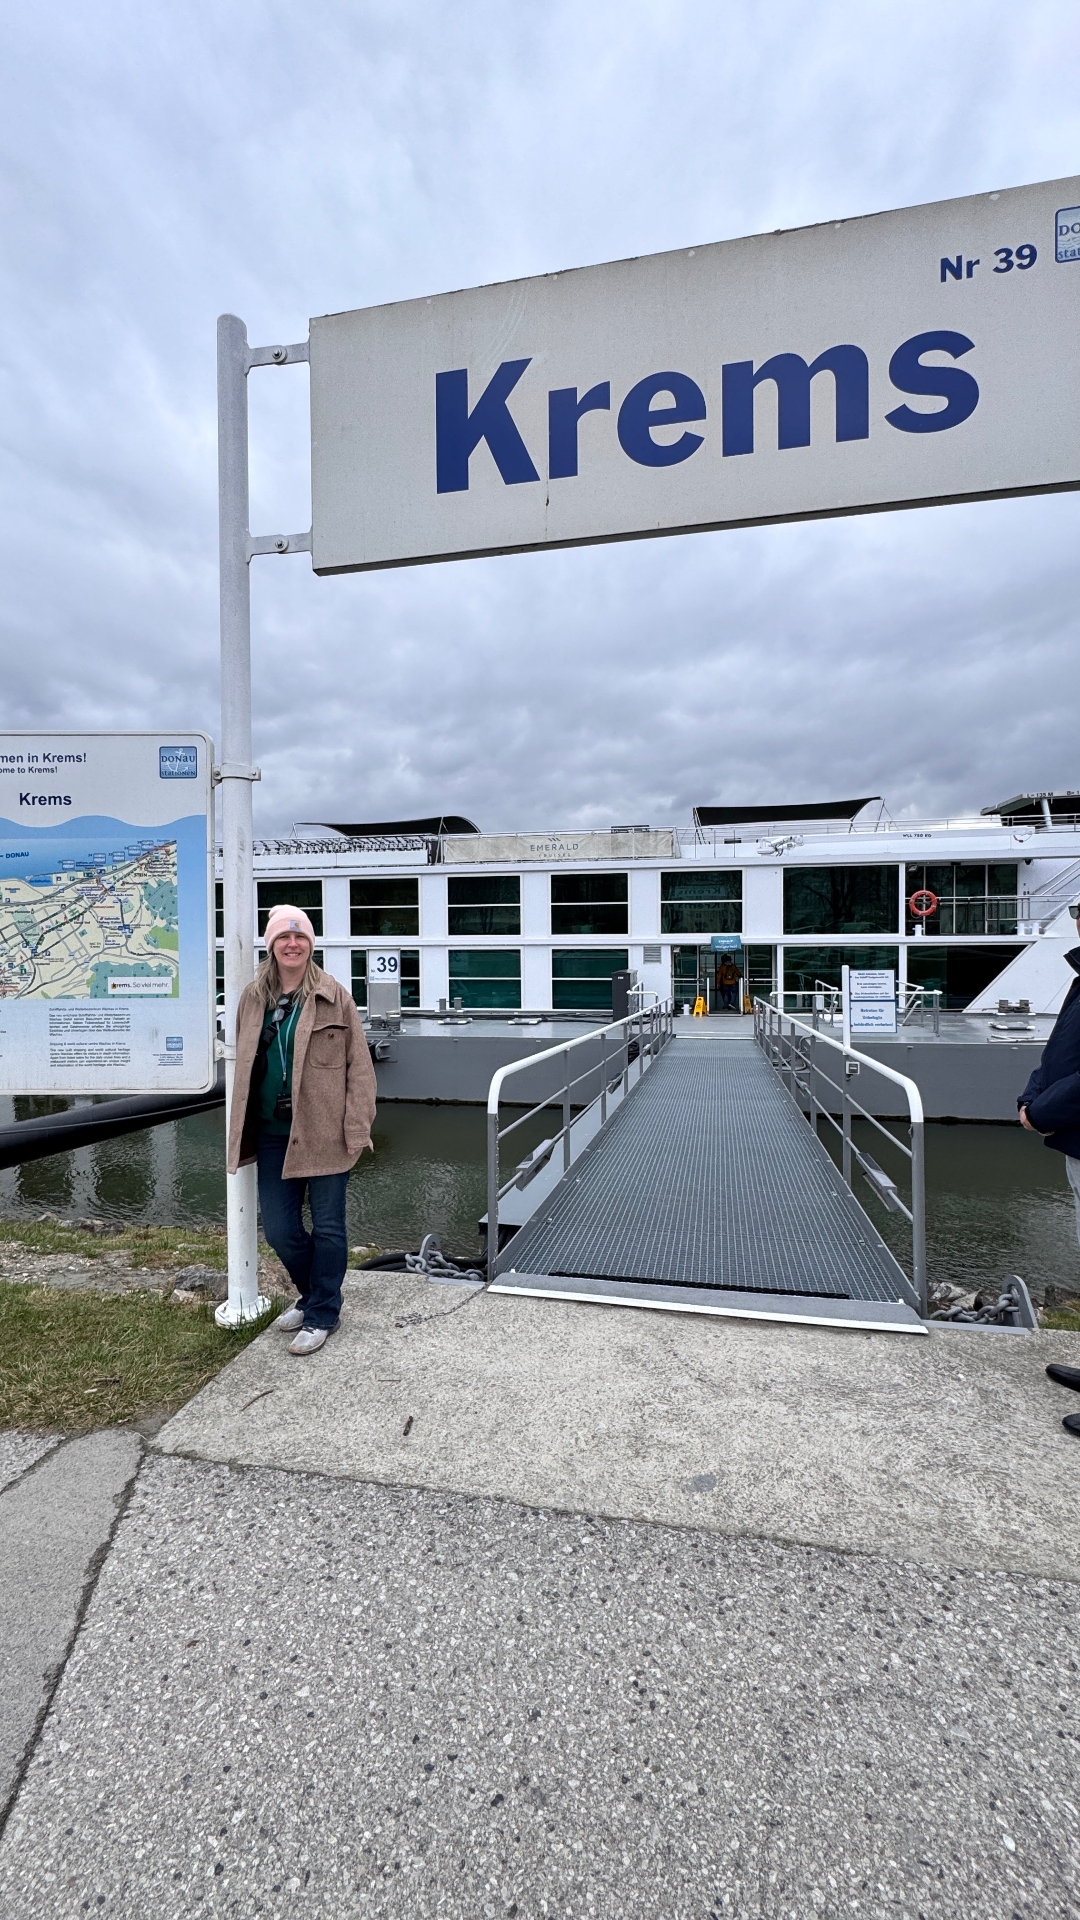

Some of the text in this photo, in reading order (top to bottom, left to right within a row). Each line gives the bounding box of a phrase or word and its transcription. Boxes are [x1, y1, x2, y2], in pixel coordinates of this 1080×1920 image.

[940, 244, 1037, 283] Nr 39
[436, 330, 979, 494] Krems
[28, 753, 38, 763] in
[43, 753, 86, 763] Krems!
[28, 766, 58, 774] Krems!
[19, 793, 72, 806] Krems
[530, 843, 579, 851] EMERALD
[377, 956, 398, 973] 39
